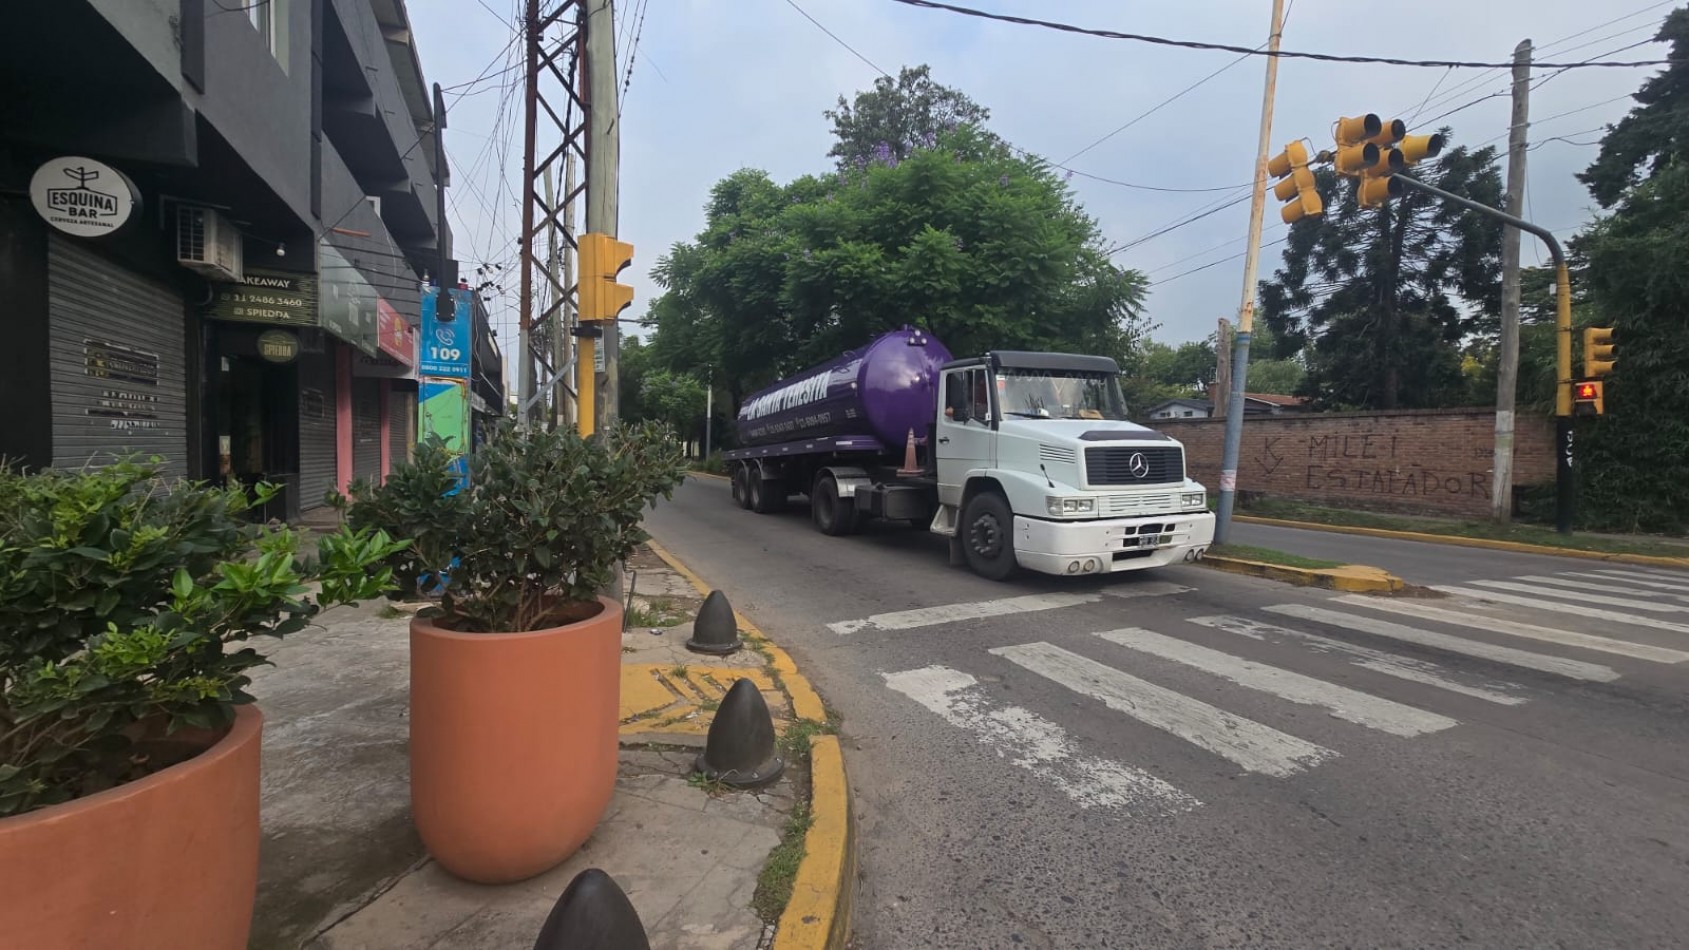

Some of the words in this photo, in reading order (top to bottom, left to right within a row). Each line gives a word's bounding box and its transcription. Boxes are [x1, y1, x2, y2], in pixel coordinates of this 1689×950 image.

[52, 191, 113, 211] ESQUINA
[68, 207, 97, 219] BAR
[430, 346, 461, 361] 109
[1308, 431, 1398, 460] MILEI
[1305, 464, 1490, 500] ESTAFADOR
